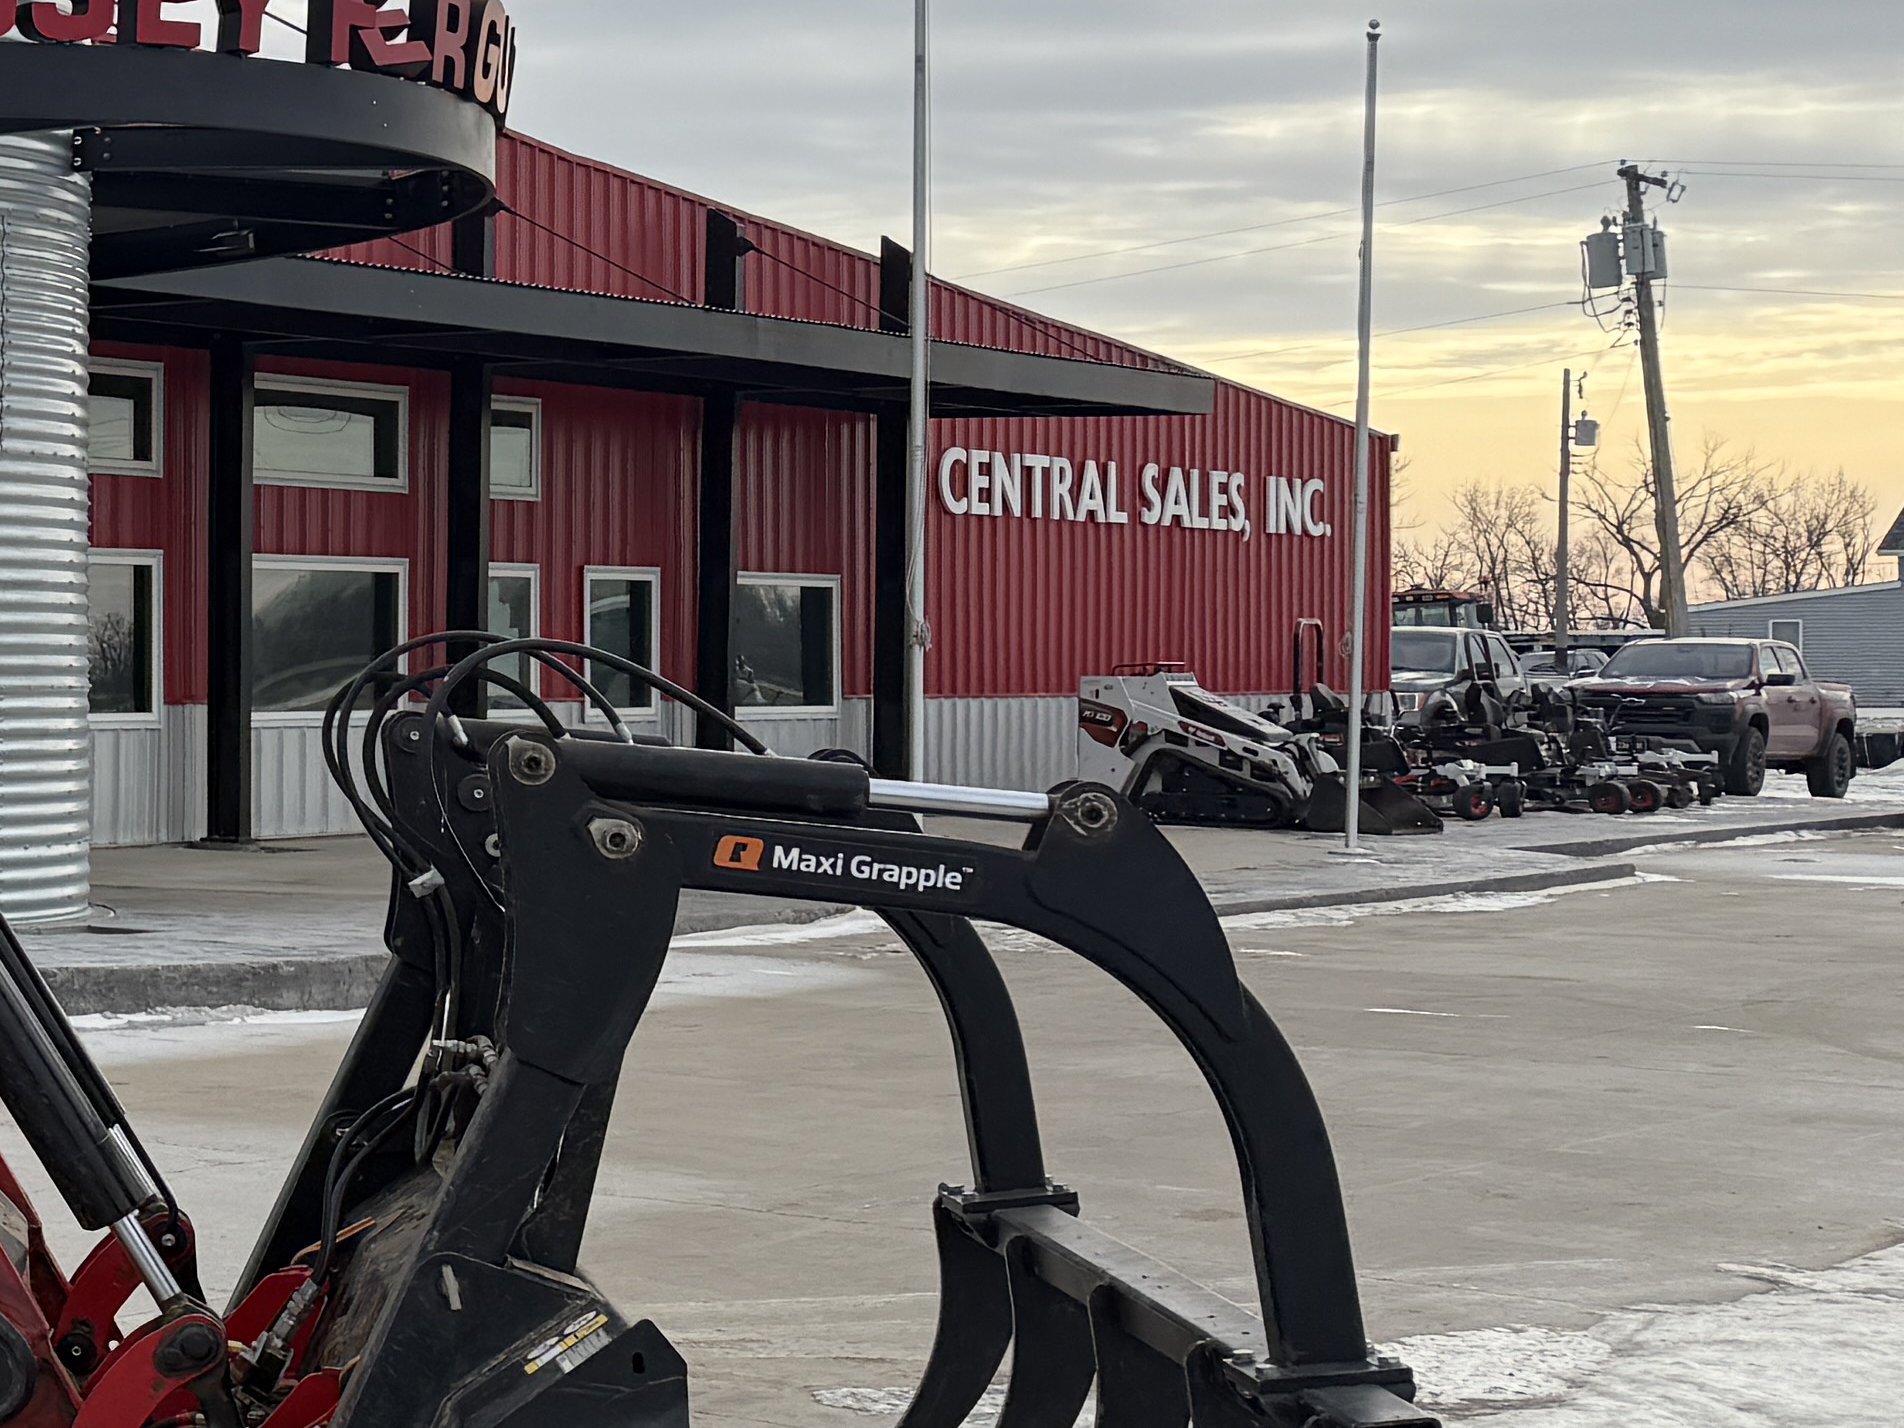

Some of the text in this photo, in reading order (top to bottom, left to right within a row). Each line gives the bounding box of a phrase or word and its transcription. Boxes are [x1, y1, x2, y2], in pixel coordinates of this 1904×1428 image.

[938, 445, 1332, 542] CENTRAL SALES, INC.
[772, 845, 844, 876] Maxi
